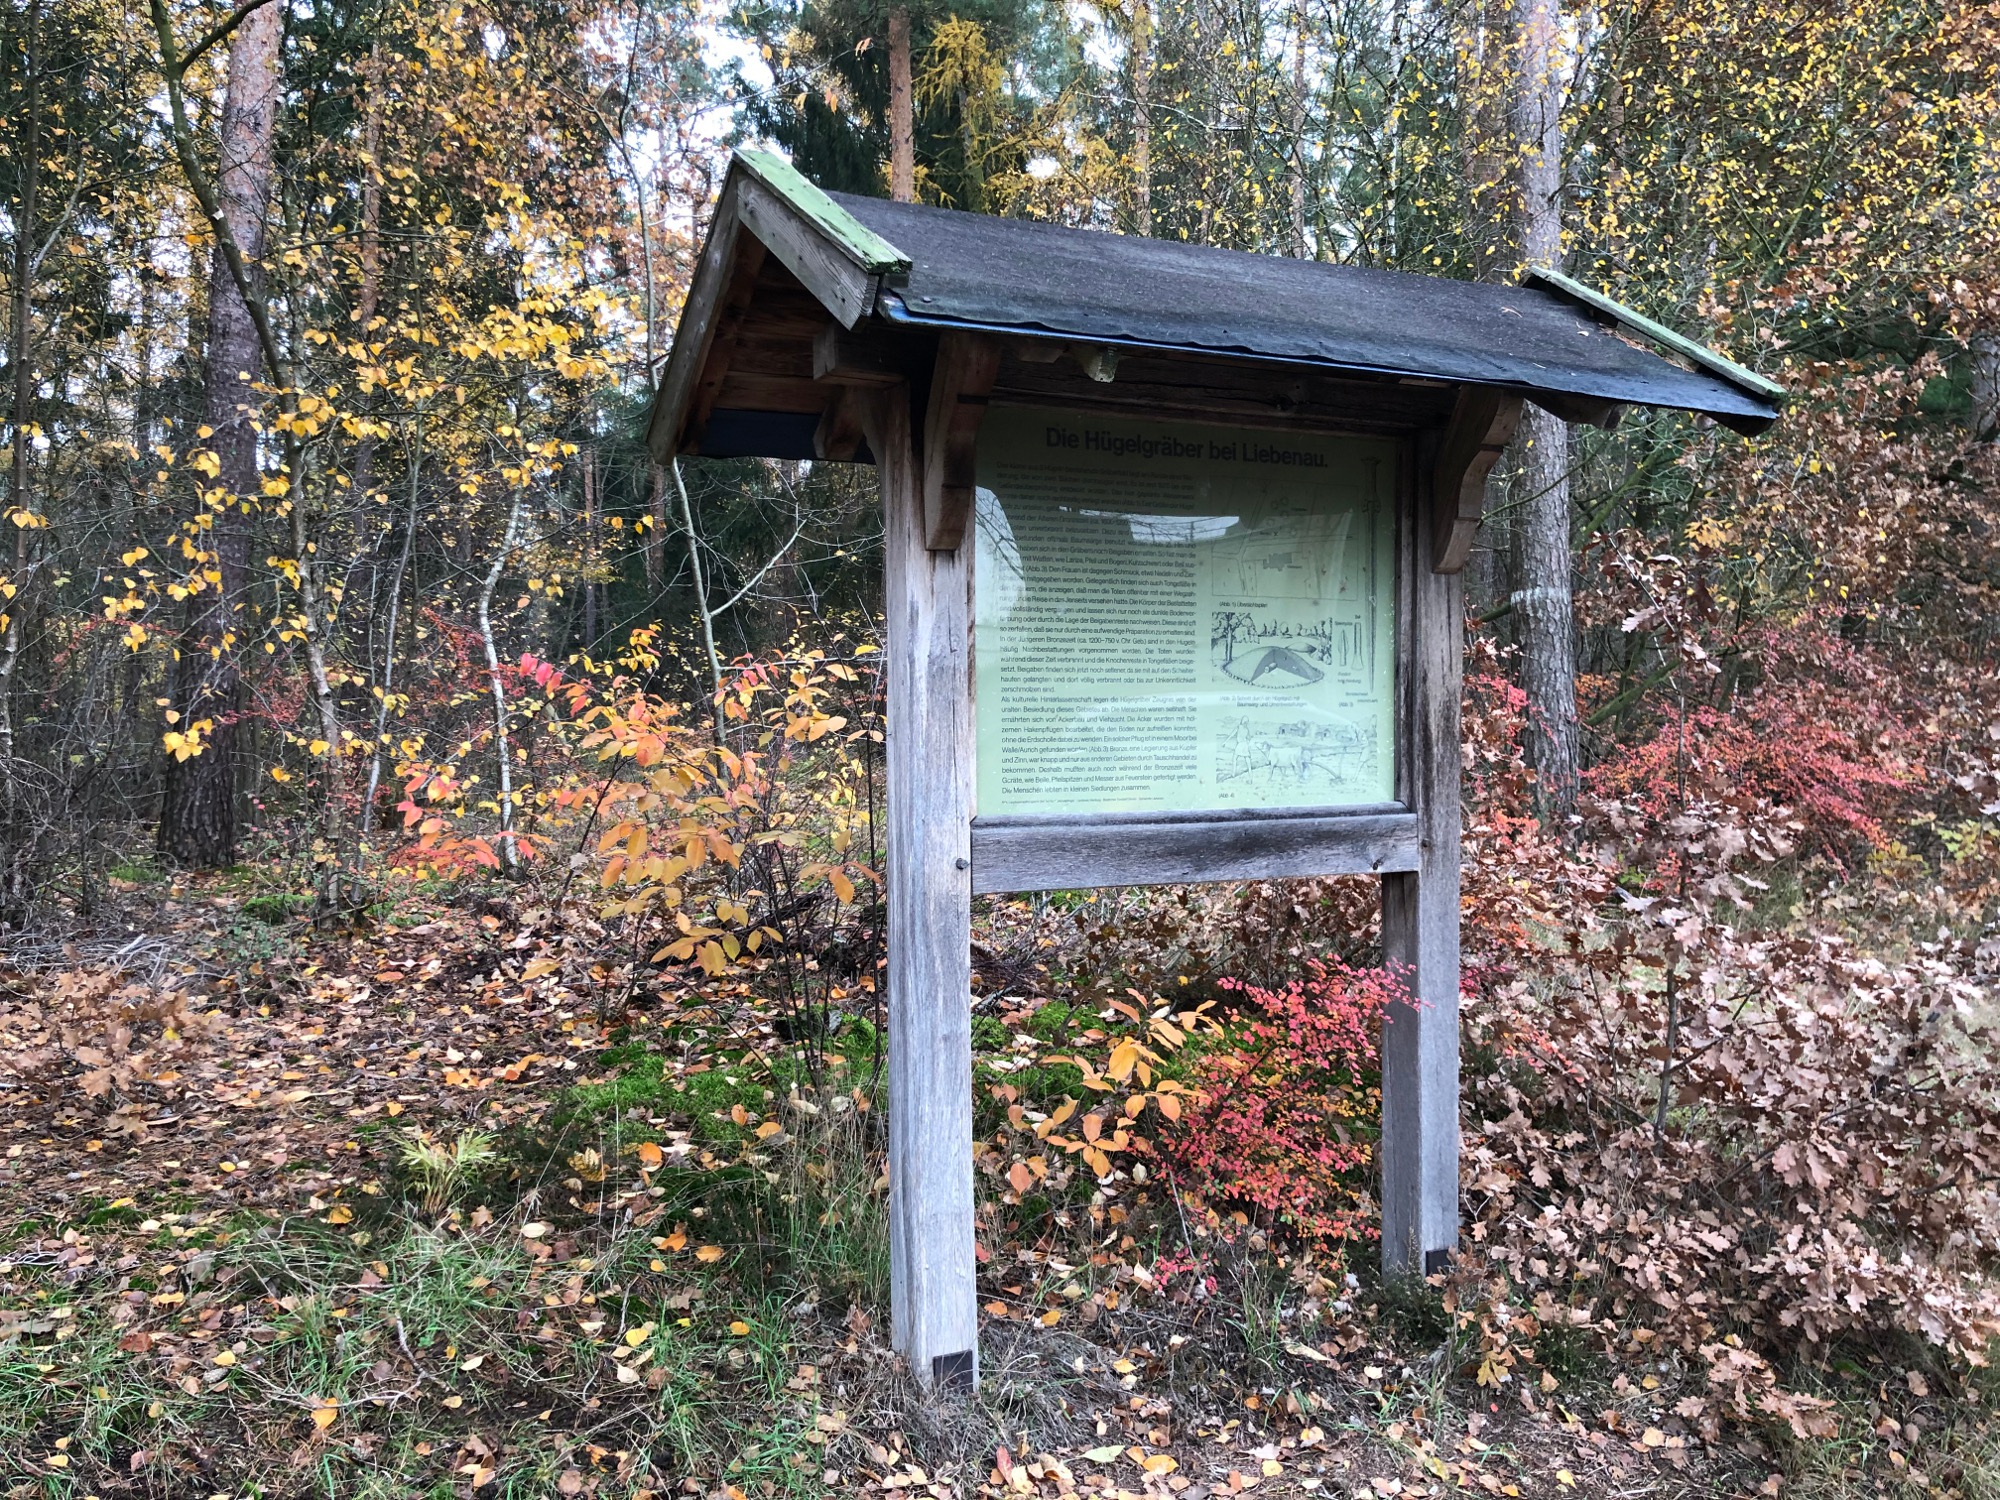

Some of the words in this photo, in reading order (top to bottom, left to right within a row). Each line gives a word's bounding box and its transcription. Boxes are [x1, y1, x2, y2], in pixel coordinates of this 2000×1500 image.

[1045, 426, 1080, 449] Die
[1084, 430, 1204, 459] Hügelgräber
[1208, 440, 1236, 461] bei
[1241, 443, 1329, 468] Liebenau.
[1065, 617, 1079, 625] Lage
[1094, 628, 1125, 636] aufwendige
[1090, 785, 1120, 793] Siedlungen
